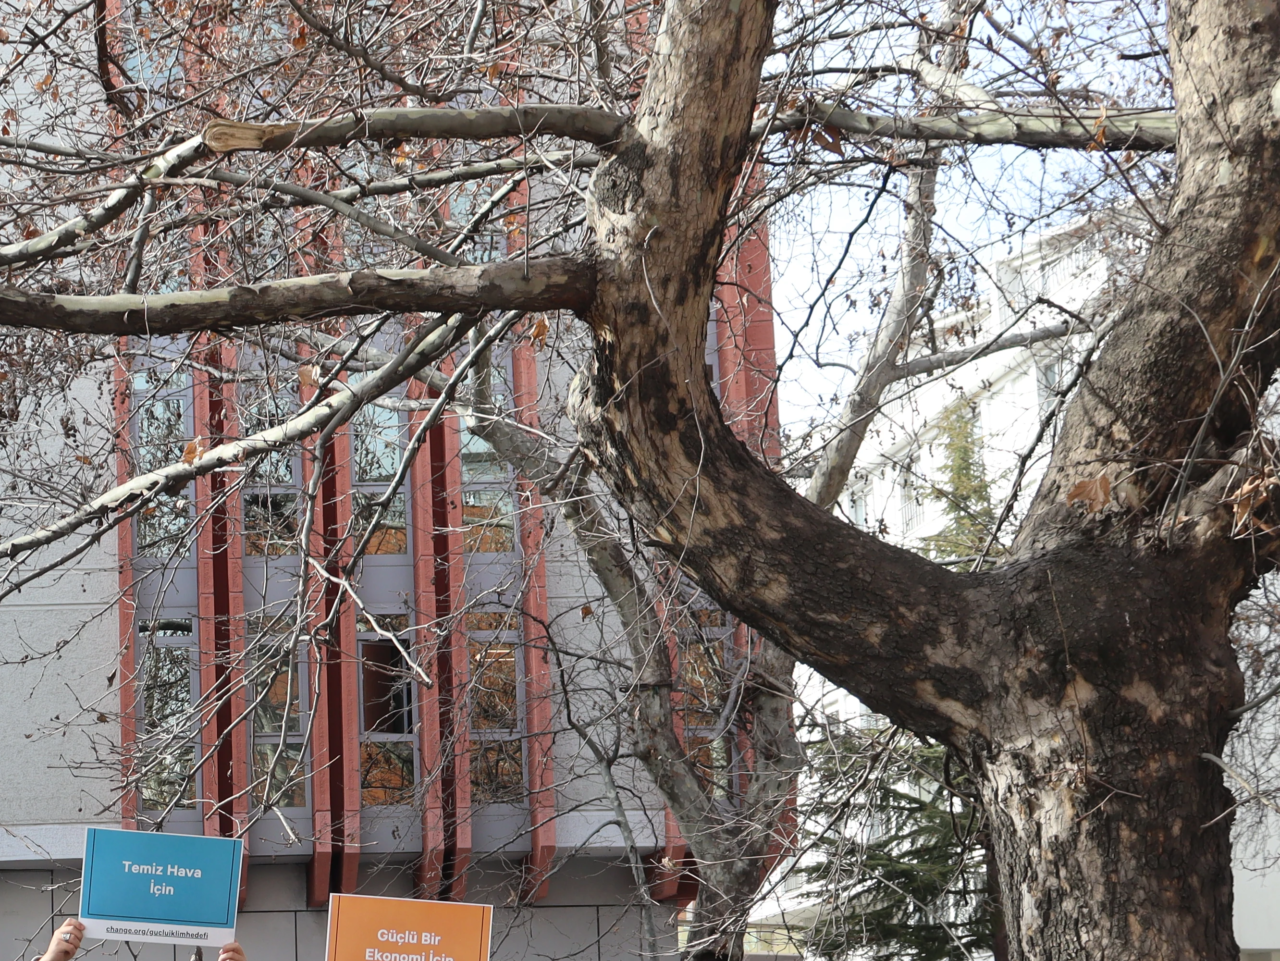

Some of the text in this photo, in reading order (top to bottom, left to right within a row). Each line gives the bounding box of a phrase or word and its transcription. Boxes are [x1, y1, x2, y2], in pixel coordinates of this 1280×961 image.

[122, 860, 202, 879] Temiz Hava
[149, 879, 174, 897] İçin
[105, 926, 209, 940] change.org/gucluiklimhedefi
[377, 929, 442, 946] Güçlü Bir
